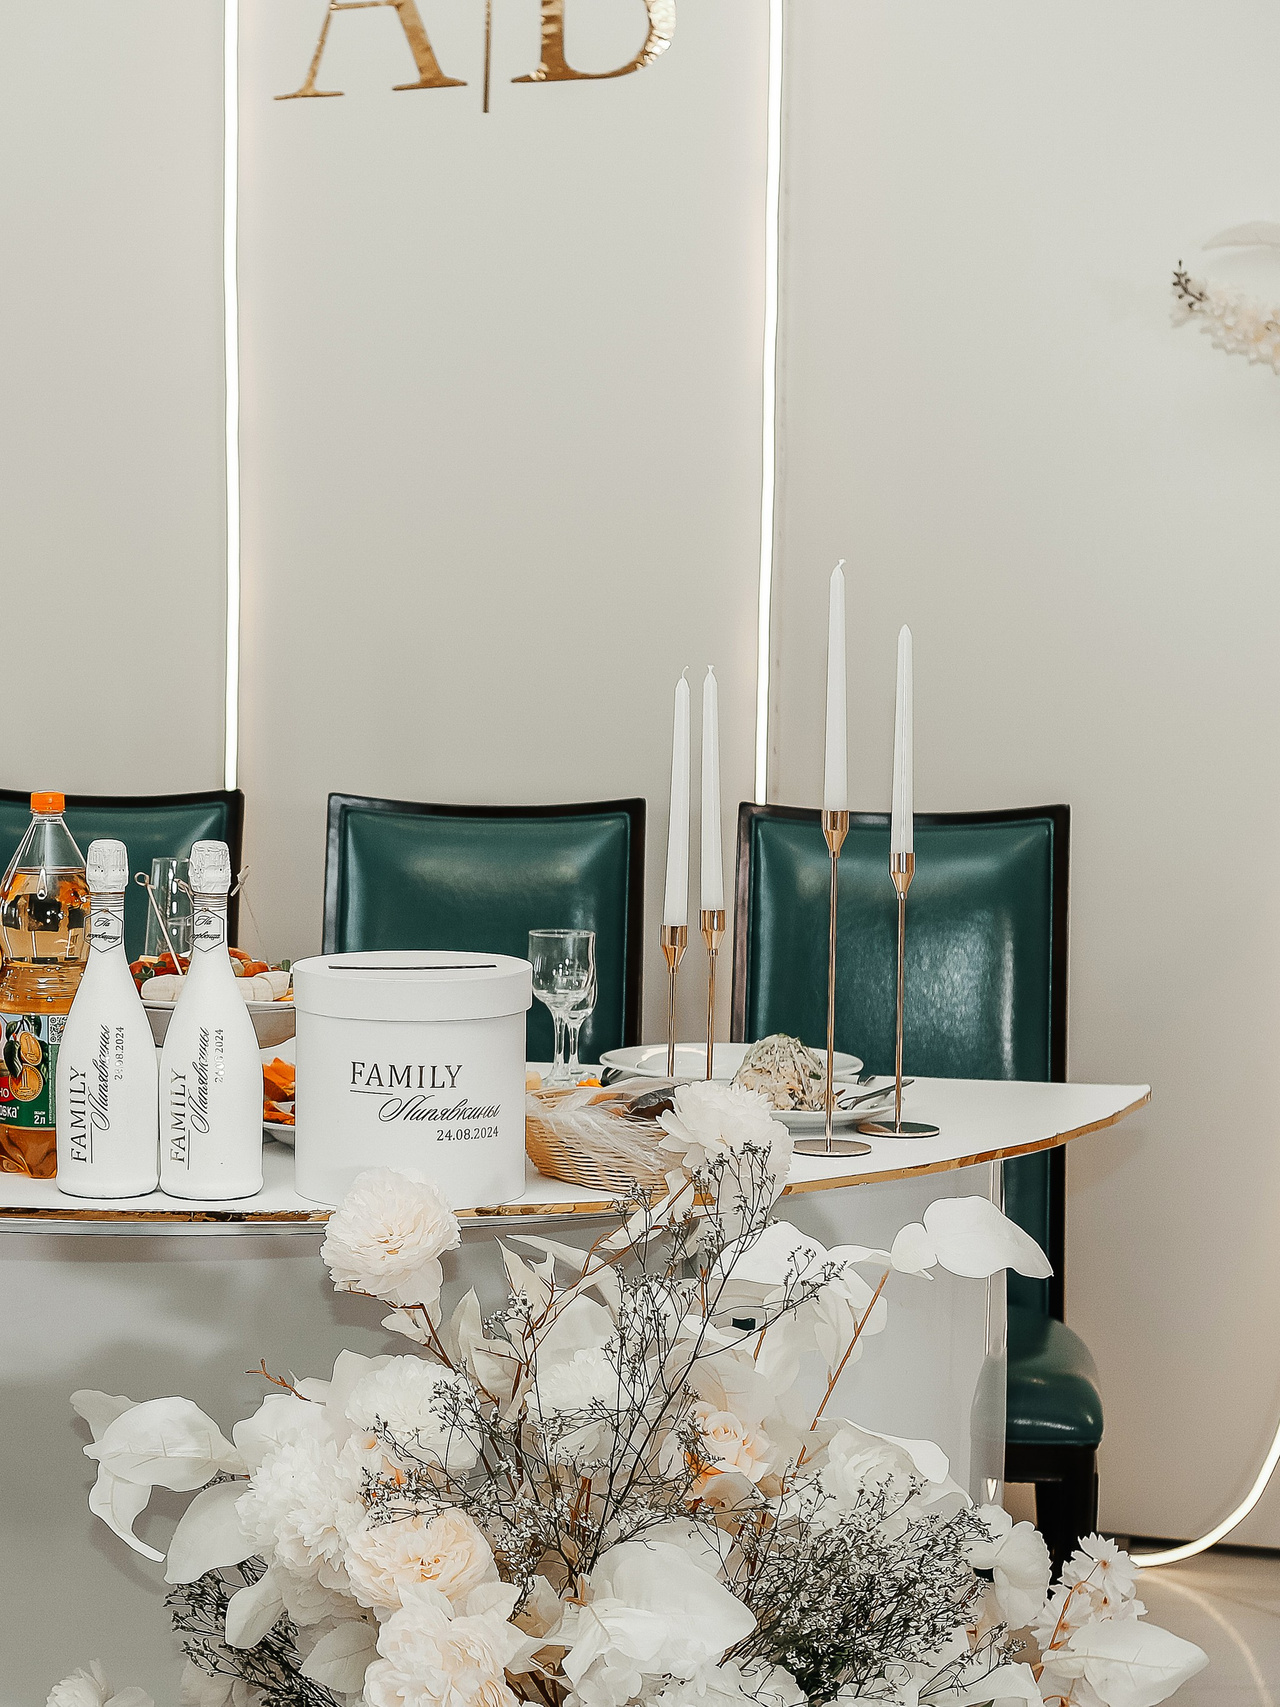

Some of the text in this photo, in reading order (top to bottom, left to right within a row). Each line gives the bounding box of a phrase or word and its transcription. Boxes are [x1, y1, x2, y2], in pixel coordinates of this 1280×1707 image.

[350, 1061, 463, 1089] FAMILY
[70, 1066, 87, 1163] FAMILY
[170, 1068, 186, 1163] FAMILY
[436, 1125, 499, 1141] 24.08.2024
